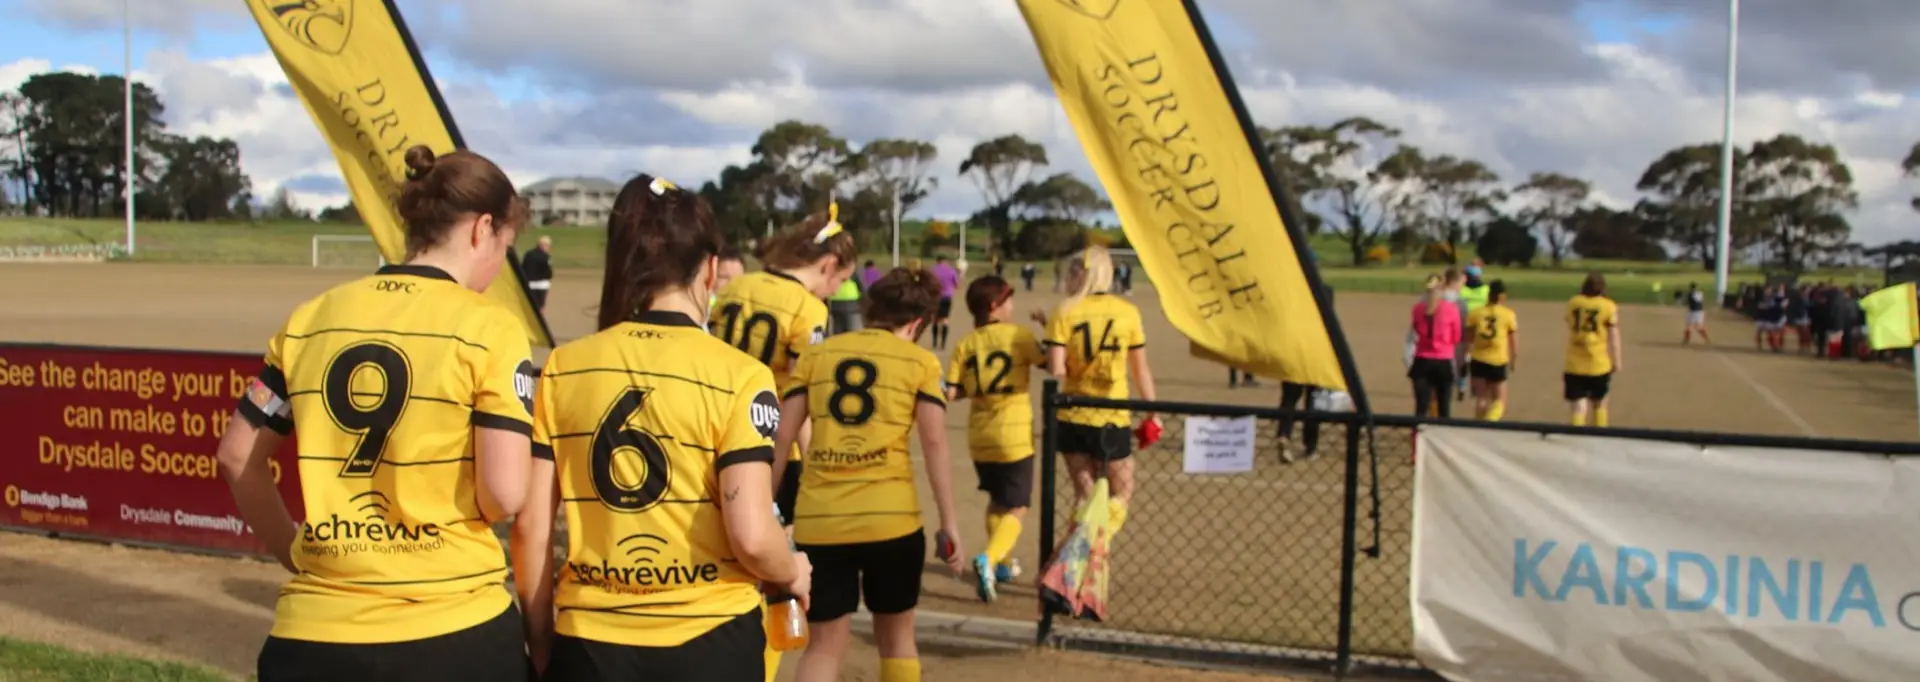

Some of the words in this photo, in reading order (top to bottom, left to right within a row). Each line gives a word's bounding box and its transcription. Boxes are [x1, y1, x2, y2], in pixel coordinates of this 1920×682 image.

[356, 79, 409, 156] DRY
[1094, 63, 1175, 212] SOCCER
[1166, 221, 1224, 321] CLUB
[1128, 53, 1265, 311] DRYSDALE
[376, 280, 417, 294] DDFC
[721, 303, 778, 366] 10
[1073, 318, 1121, 363] 14
[1480, 316, 1497, 340] 3
[1571, 307, 1600, 333] 13
[0, 357, 35, 388] See
[40, 359, 77, 388] the
[83, 361, 167, 400] change
[173, 375, 224, 402] your
[829, 357, 877, 427] 8
[964, 350, 1014, 395] 12
[64, 404, 104, 429] can
[110, 403, 176, 435] make
[183, 407, 206, 437] to
[212, 407, 232, 439] th
[321, 338, 413, 478] 9
[39, 436, 136, 472] Drysdale
[140, 443, 219, 478] Soccer
[590, 385, 673, 514] 6
[120, 503, 172, 526] Drysdale
[174, 509, 245, 536] Community
[342, 542, 368, 556] you
[1511, 537, 1886, 629] KARDINIA
